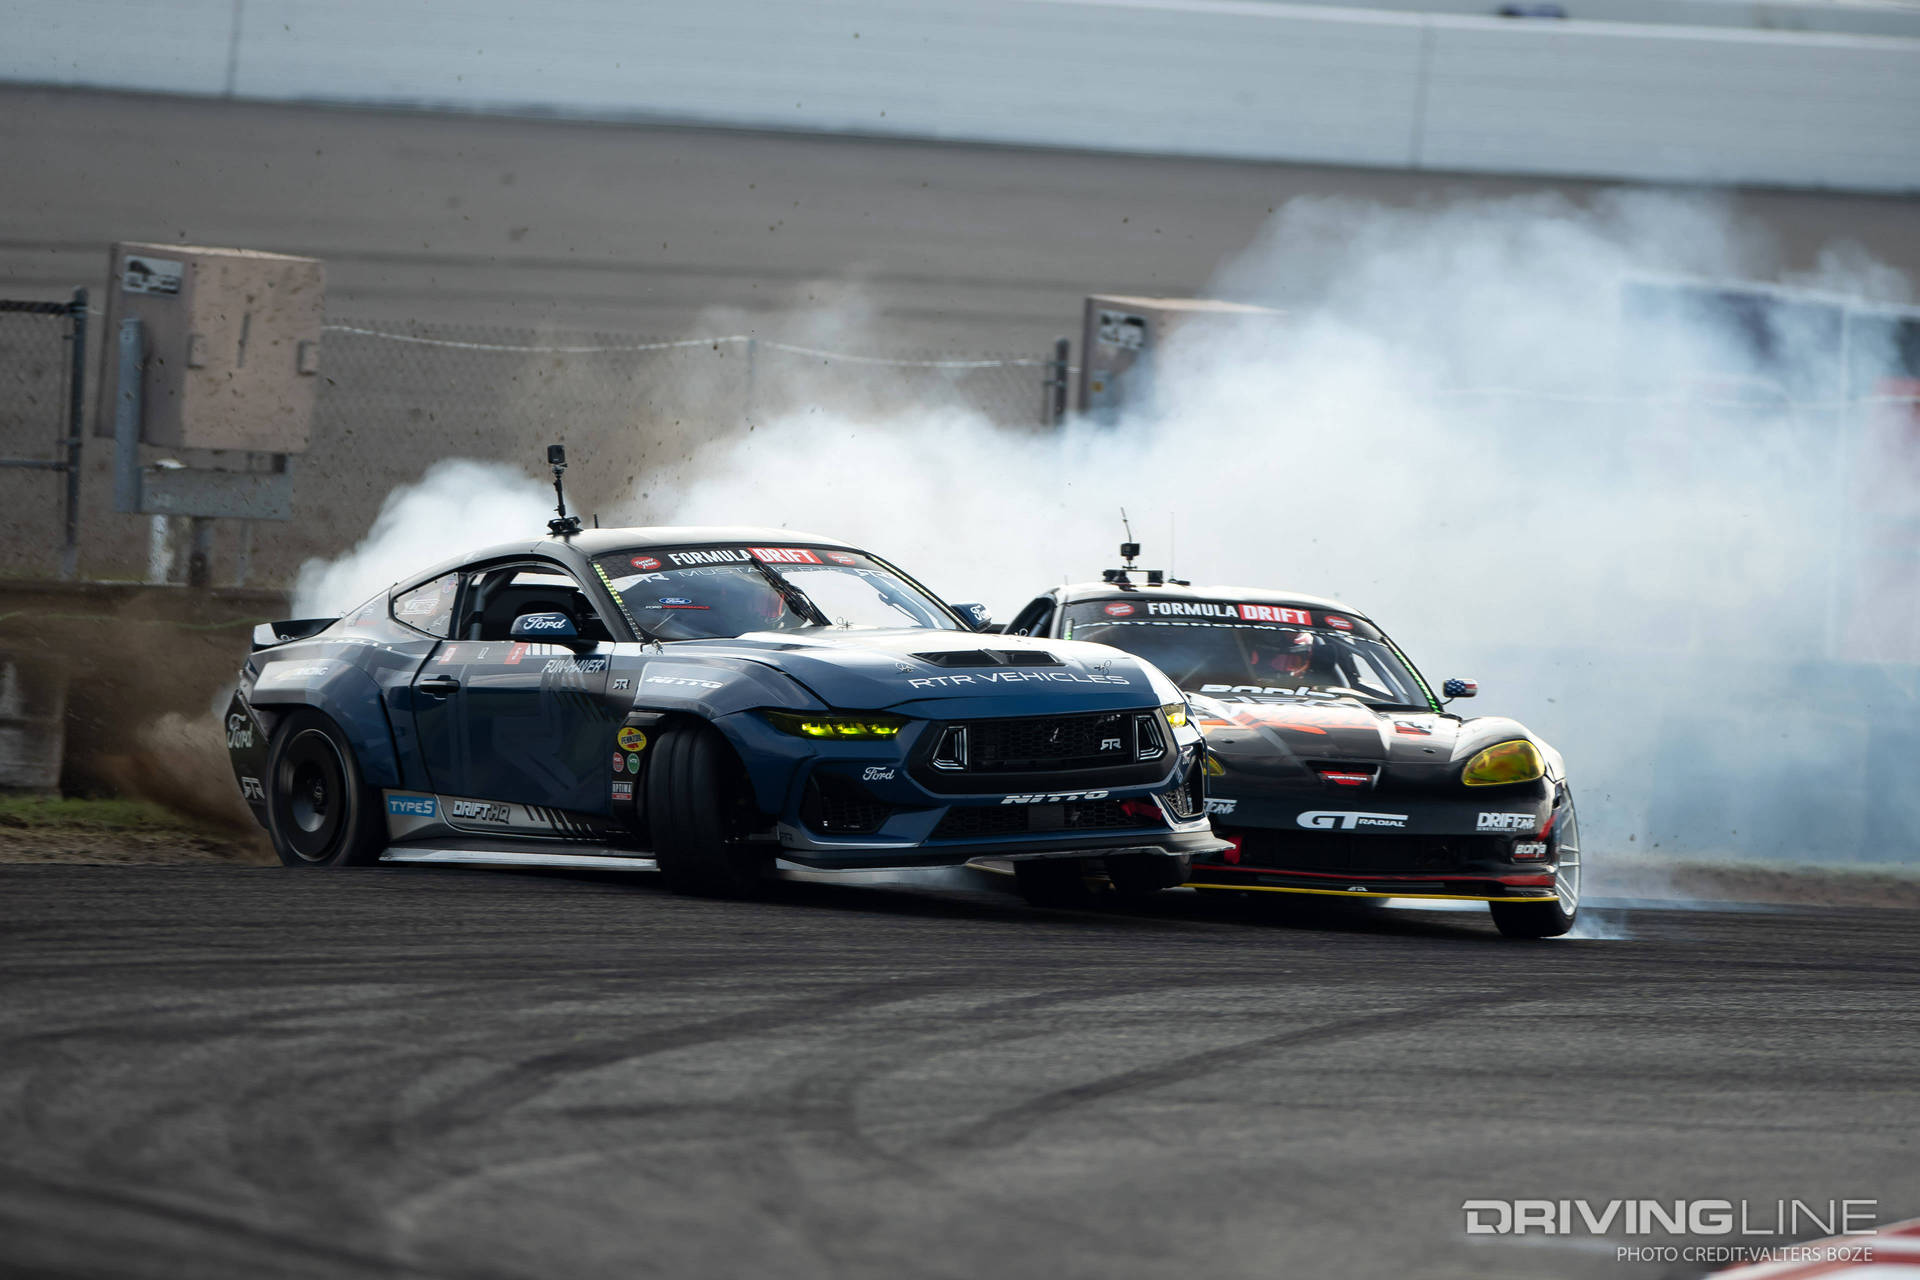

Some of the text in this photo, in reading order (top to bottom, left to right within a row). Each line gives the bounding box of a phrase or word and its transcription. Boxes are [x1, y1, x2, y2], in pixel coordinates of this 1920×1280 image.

[667, 549, 752, 566] FORMULA
[752, 548, 817, 563] DRIFT
[1147, 602, 1239, 618] FORMULA
[1243, 605, 1307, 624] DRIFT
[523, 616, 566, 630] Ford
[541, 659, 606, 673] FUN-HAVER
[907, 672, 1130, 689] RTR VEHICLES
[228, 713, 254, 749] Ford
[862, 766, 895, 780] Ford
[1001, 790, 1110, 805] NITTO
[1357, 817, 1407, 828] RADIAL
